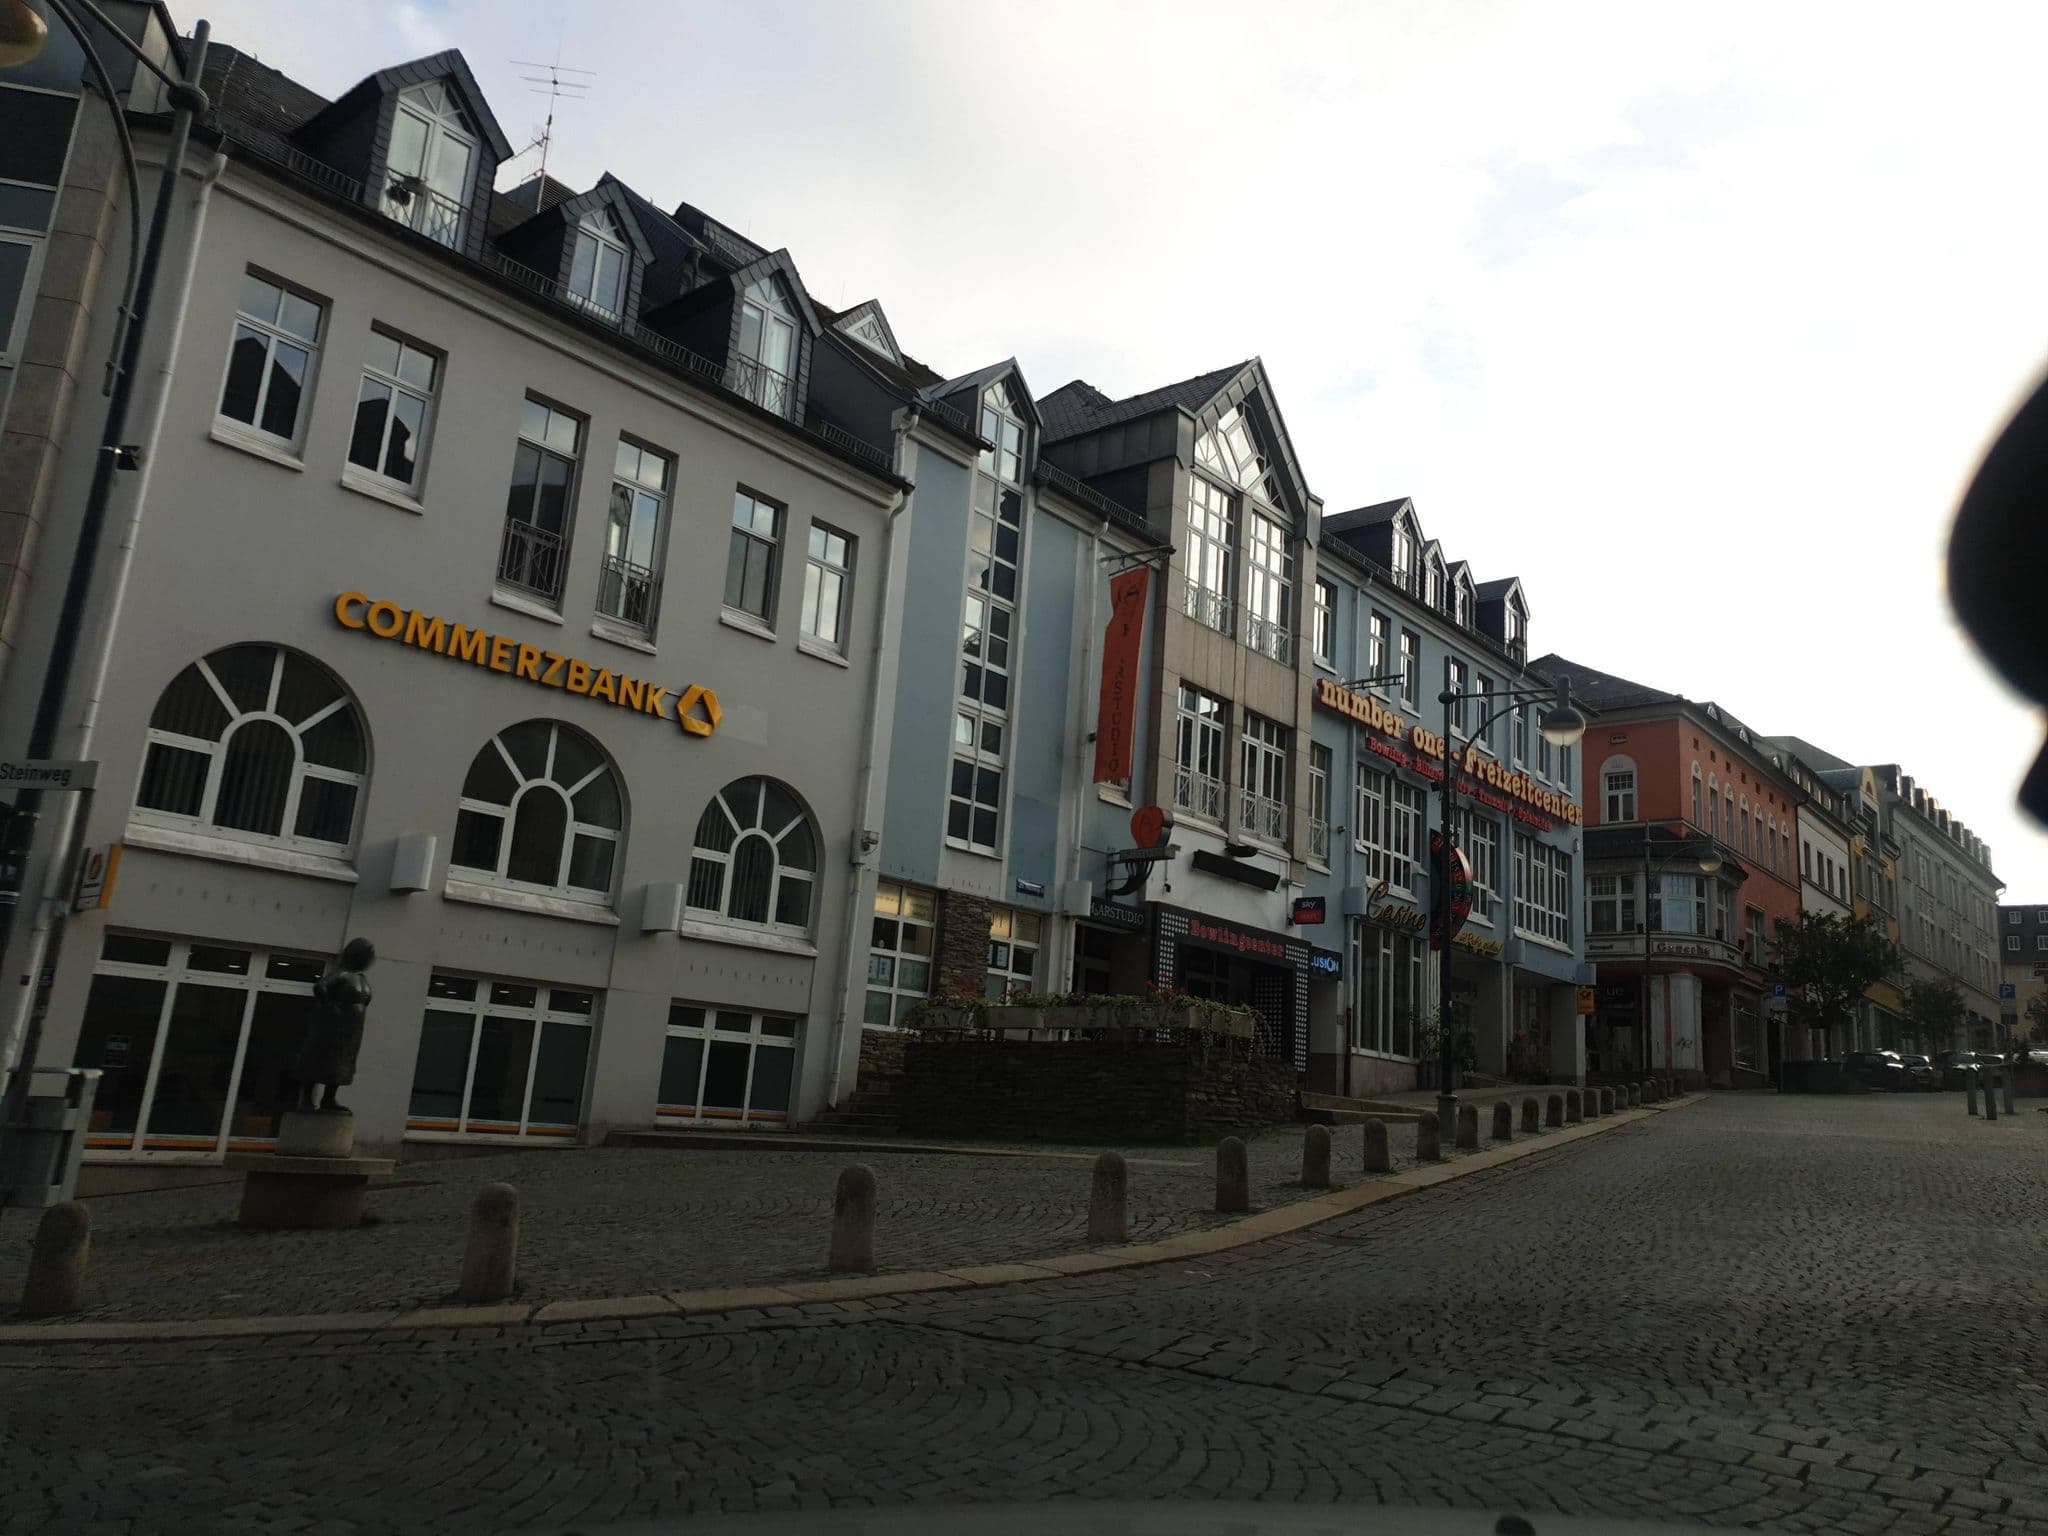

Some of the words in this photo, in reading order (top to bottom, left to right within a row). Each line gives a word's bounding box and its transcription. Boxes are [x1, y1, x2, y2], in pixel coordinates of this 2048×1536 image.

[335, 591, 669, 719] COMMERZBANK
[1318, 678, 1404, 739] number
[1409, 725, 1446, 760] one
[0, 762, 72, 786] Steinweg
[1301, 900, 1317, 911] sky
[1367, 880, 1427, 932] Casino
